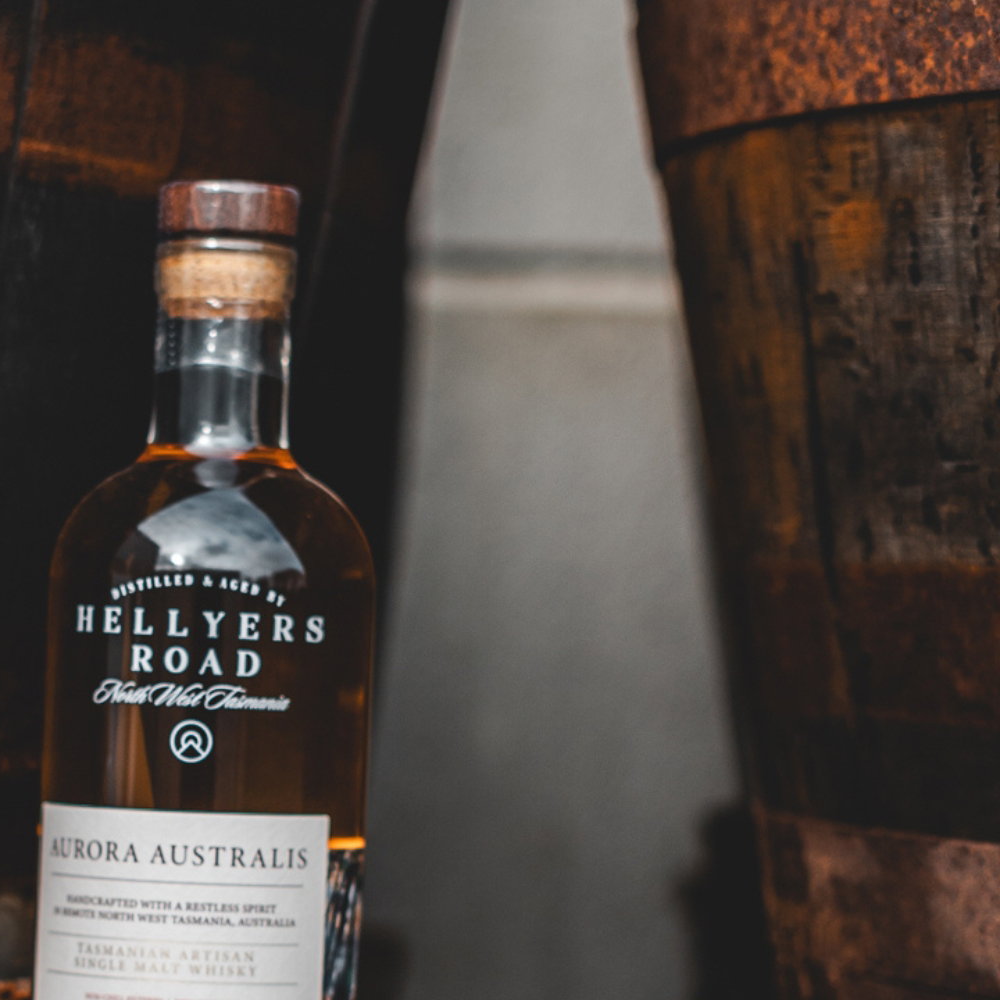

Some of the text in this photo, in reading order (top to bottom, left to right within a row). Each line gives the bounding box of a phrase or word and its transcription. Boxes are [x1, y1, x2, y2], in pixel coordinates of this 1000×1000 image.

[110, 574, 286, 608] DISTILLED & AGED BY
[76, 605, 325, 643] HELLYERS
[131, 644, 261, 677] ROAD
[93, 678, 291, 710] North West Tasmania
[49, 837, 308, 870] AURORA AUSTRALIS
[98, 911, 134, 922] NORTH
[137, 913, 166, 925] WEST
[238, 917, 296, 928] AUSTRALIA
[141, 899, 172, 910] WITH
[175, 902, 182, 910] A
[185, 902, 239, 913] RESTLESS
[242, 904, 277, 914] SPIRIT
[75, 956, 257, 977] SINGLE MALT WHISKY
[77, 942, 255, 962] TASMANIAN ARTISAN
